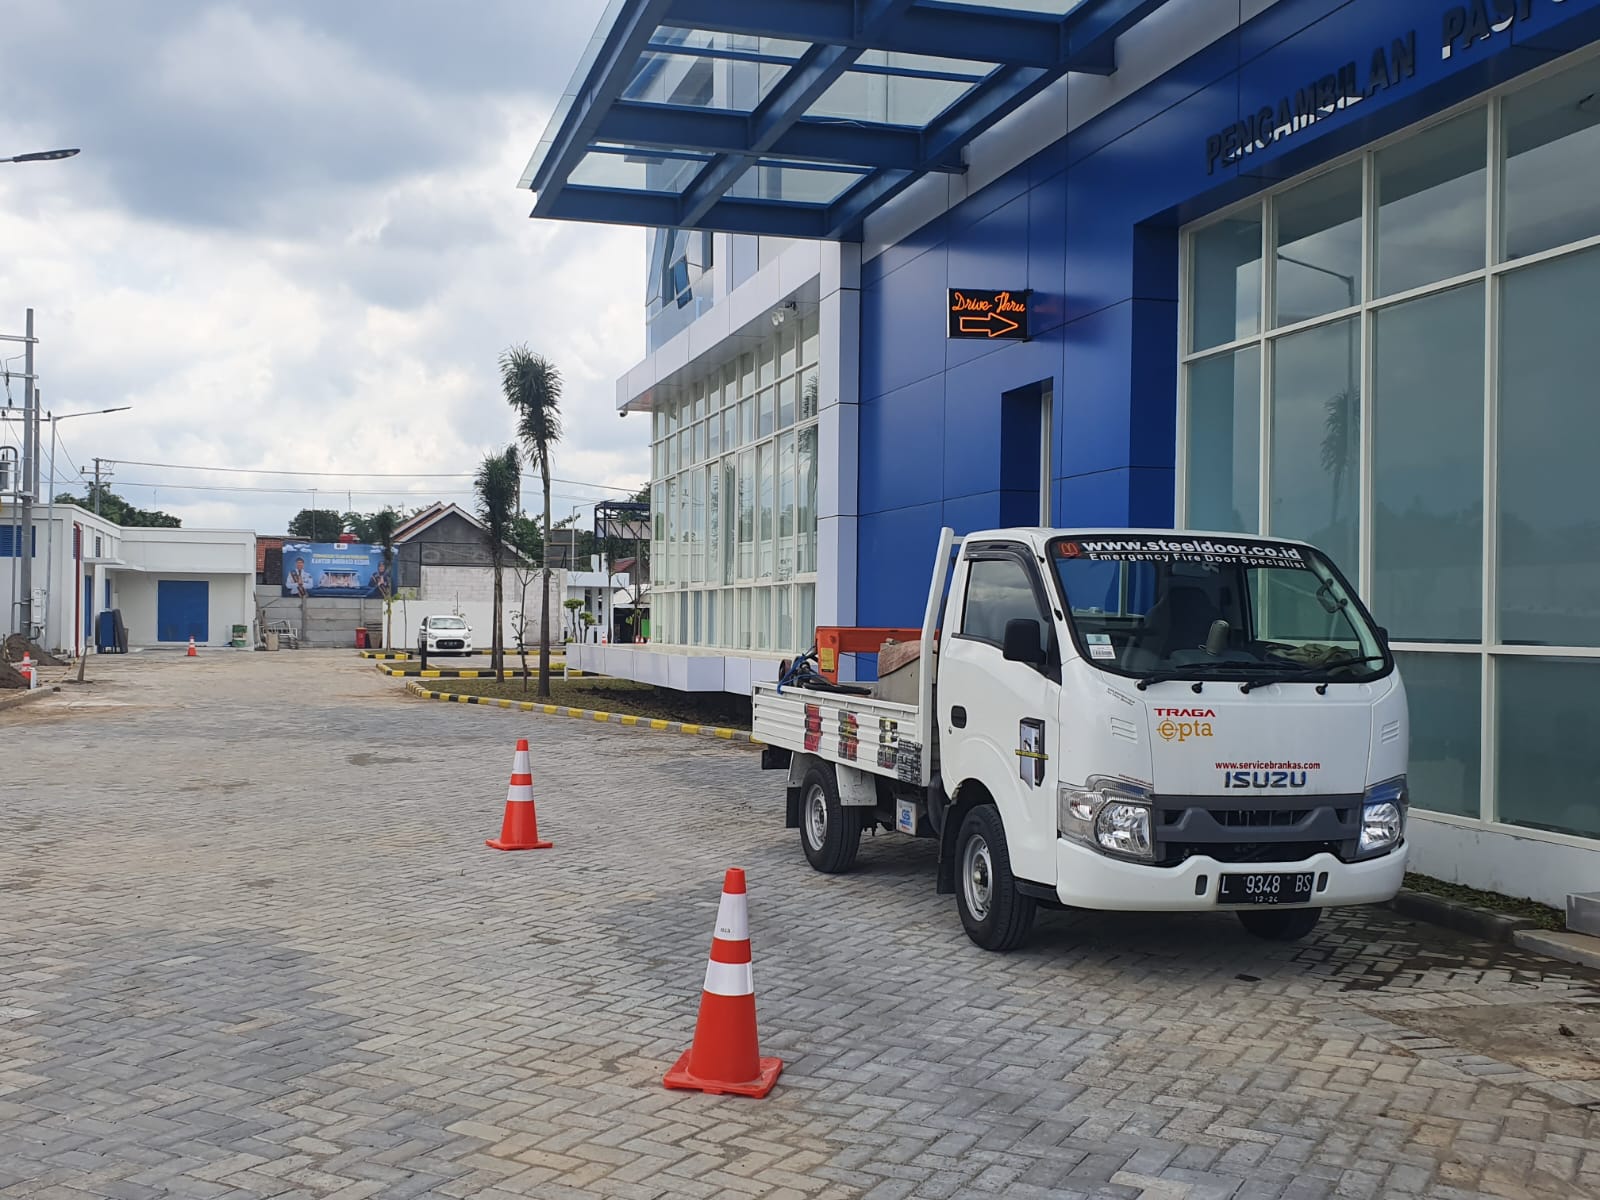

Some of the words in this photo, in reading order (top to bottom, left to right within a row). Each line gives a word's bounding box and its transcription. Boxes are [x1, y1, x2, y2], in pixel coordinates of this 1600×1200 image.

[1207, 30, 1416, 175] PENGAMBILAN
[951, 292, 992, 311] Drive
[994, 292, 1026, 313] Thru
[1081, 540, 1302, 560] www.steeldoor.co.id
[1089, 553, 1169, 562] Emergency
[1173, 553, 1201, 562] Fire
[1204, 555, 1237, 563] Door
[1240, 556, 1307, 569] Specialist
[1154, 708, 1216, 717] TRAGA
[1158, 718, 1214, 742] epta
[1215, 760, 1321, 770] www.servicebrankas.com
[1225, 771, 1307, 788] ISUZU
[1221, 875, 1230, 894] L
[1246, 875, 1281, 894] 9348
[1295, 874, 1312, 893] BS
